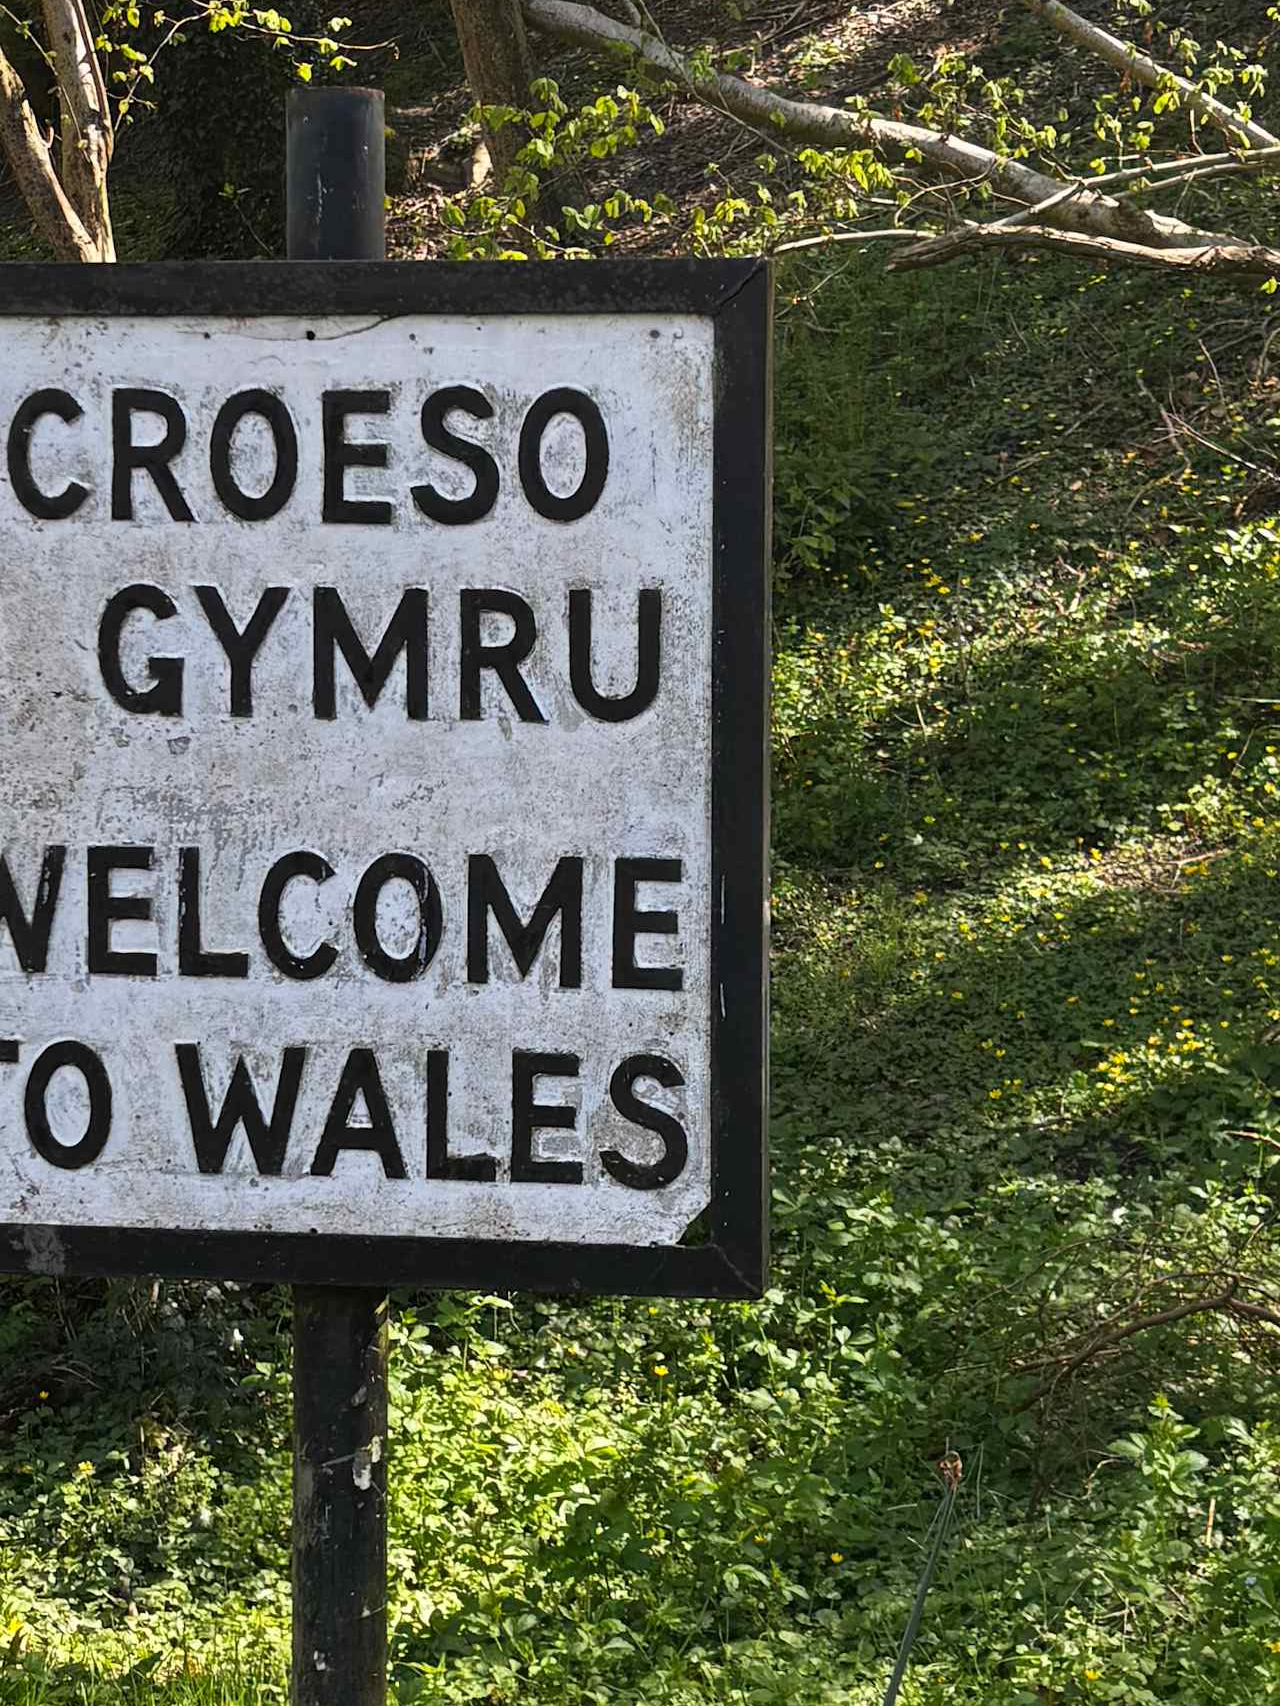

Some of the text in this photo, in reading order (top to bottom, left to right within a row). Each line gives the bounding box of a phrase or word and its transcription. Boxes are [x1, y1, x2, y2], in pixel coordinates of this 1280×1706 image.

[5, 383, 611, 527] CROESO
[96, 582, 664, 727] GYMRU
[173, 1040, 690, 1193] WALES
